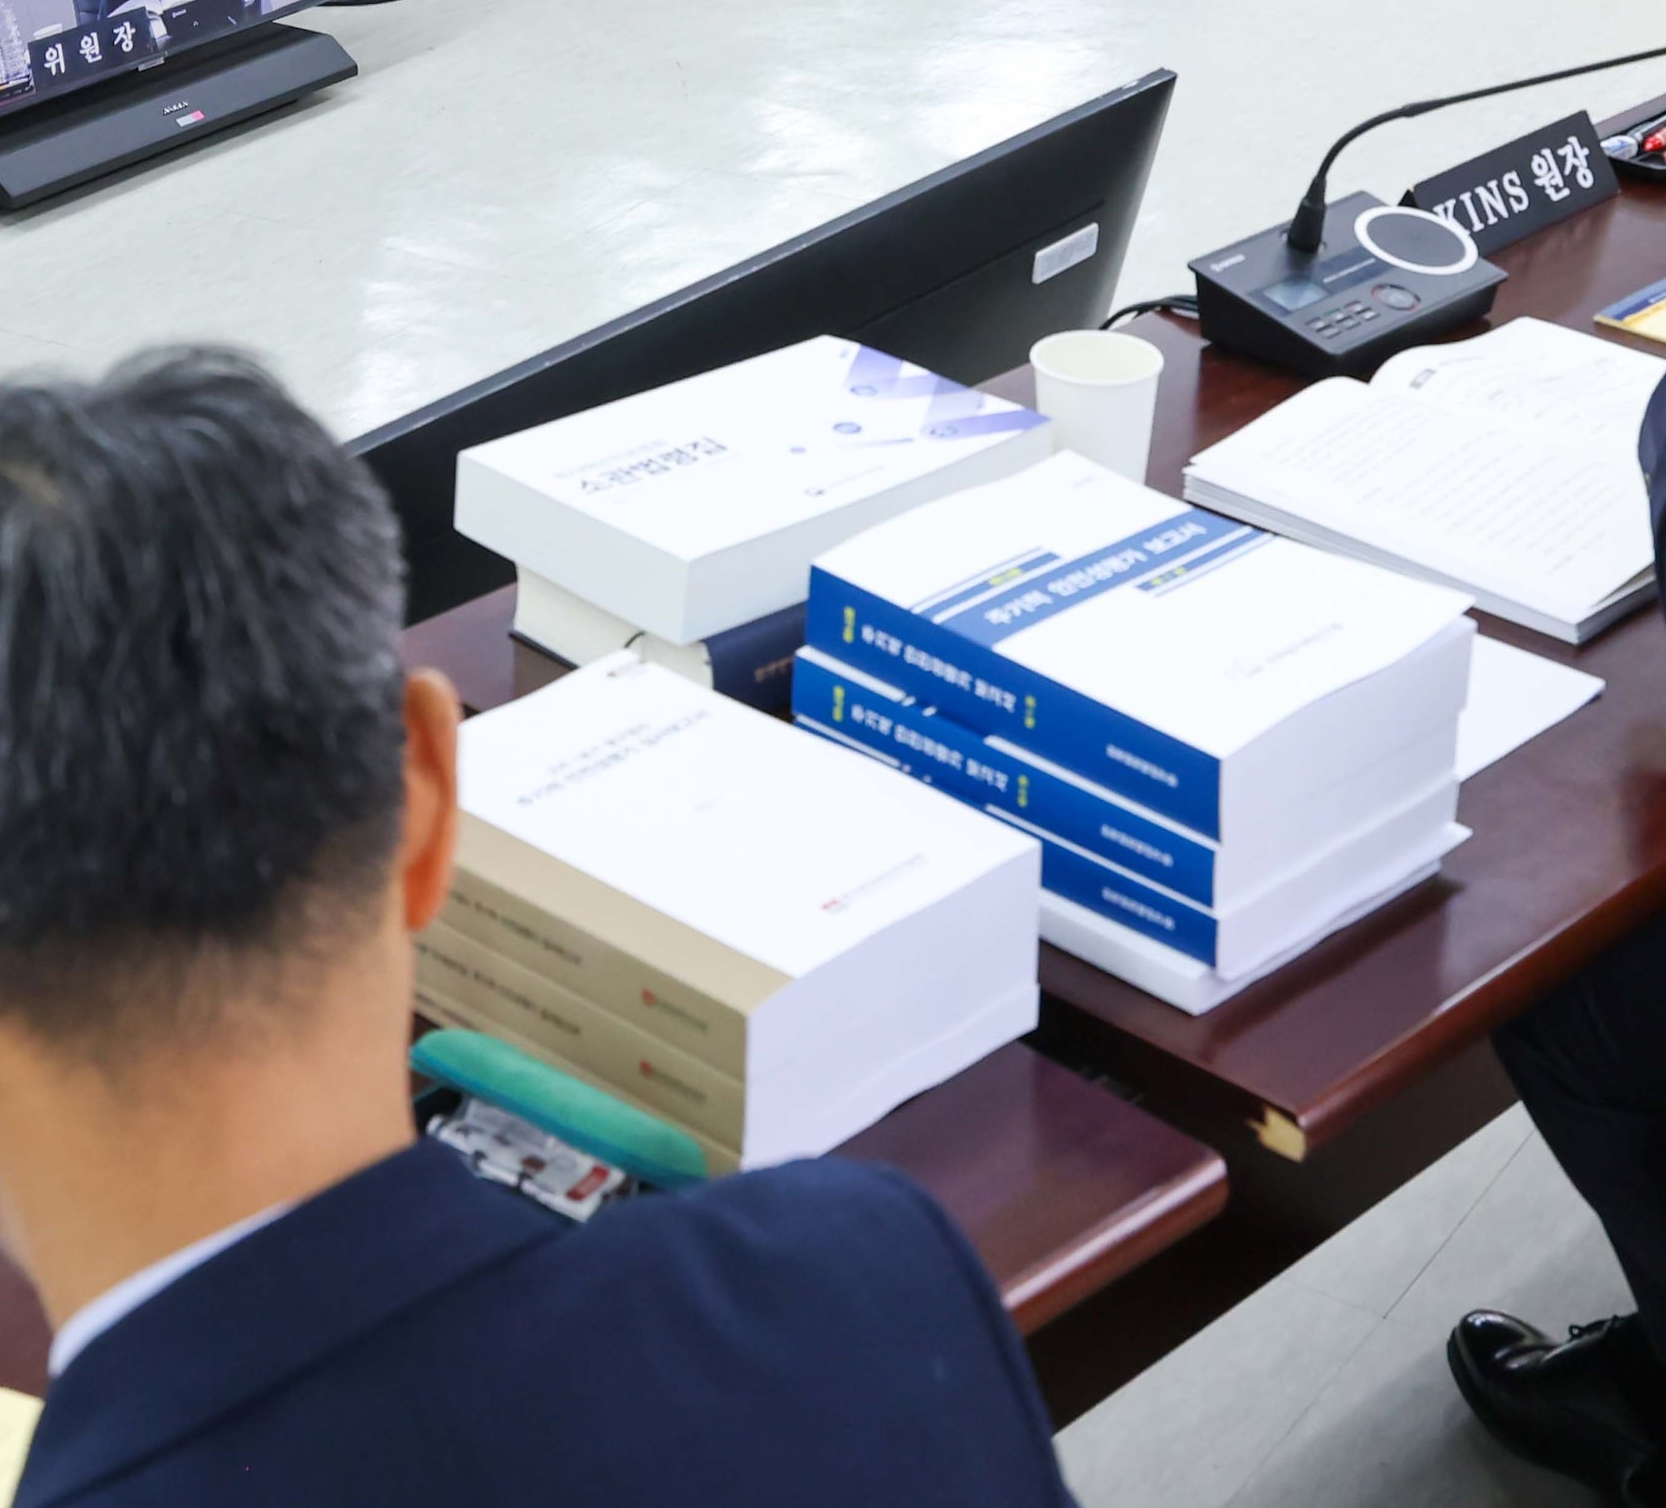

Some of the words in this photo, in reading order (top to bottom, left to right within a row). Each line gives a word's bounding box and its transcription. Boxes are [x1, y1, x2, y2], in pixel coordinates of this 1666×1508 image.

[43, 21, 137, 77] 위원장
[1432, 169, 1530, 236] KINS
[1531, 135, 1595, 203] 원장
